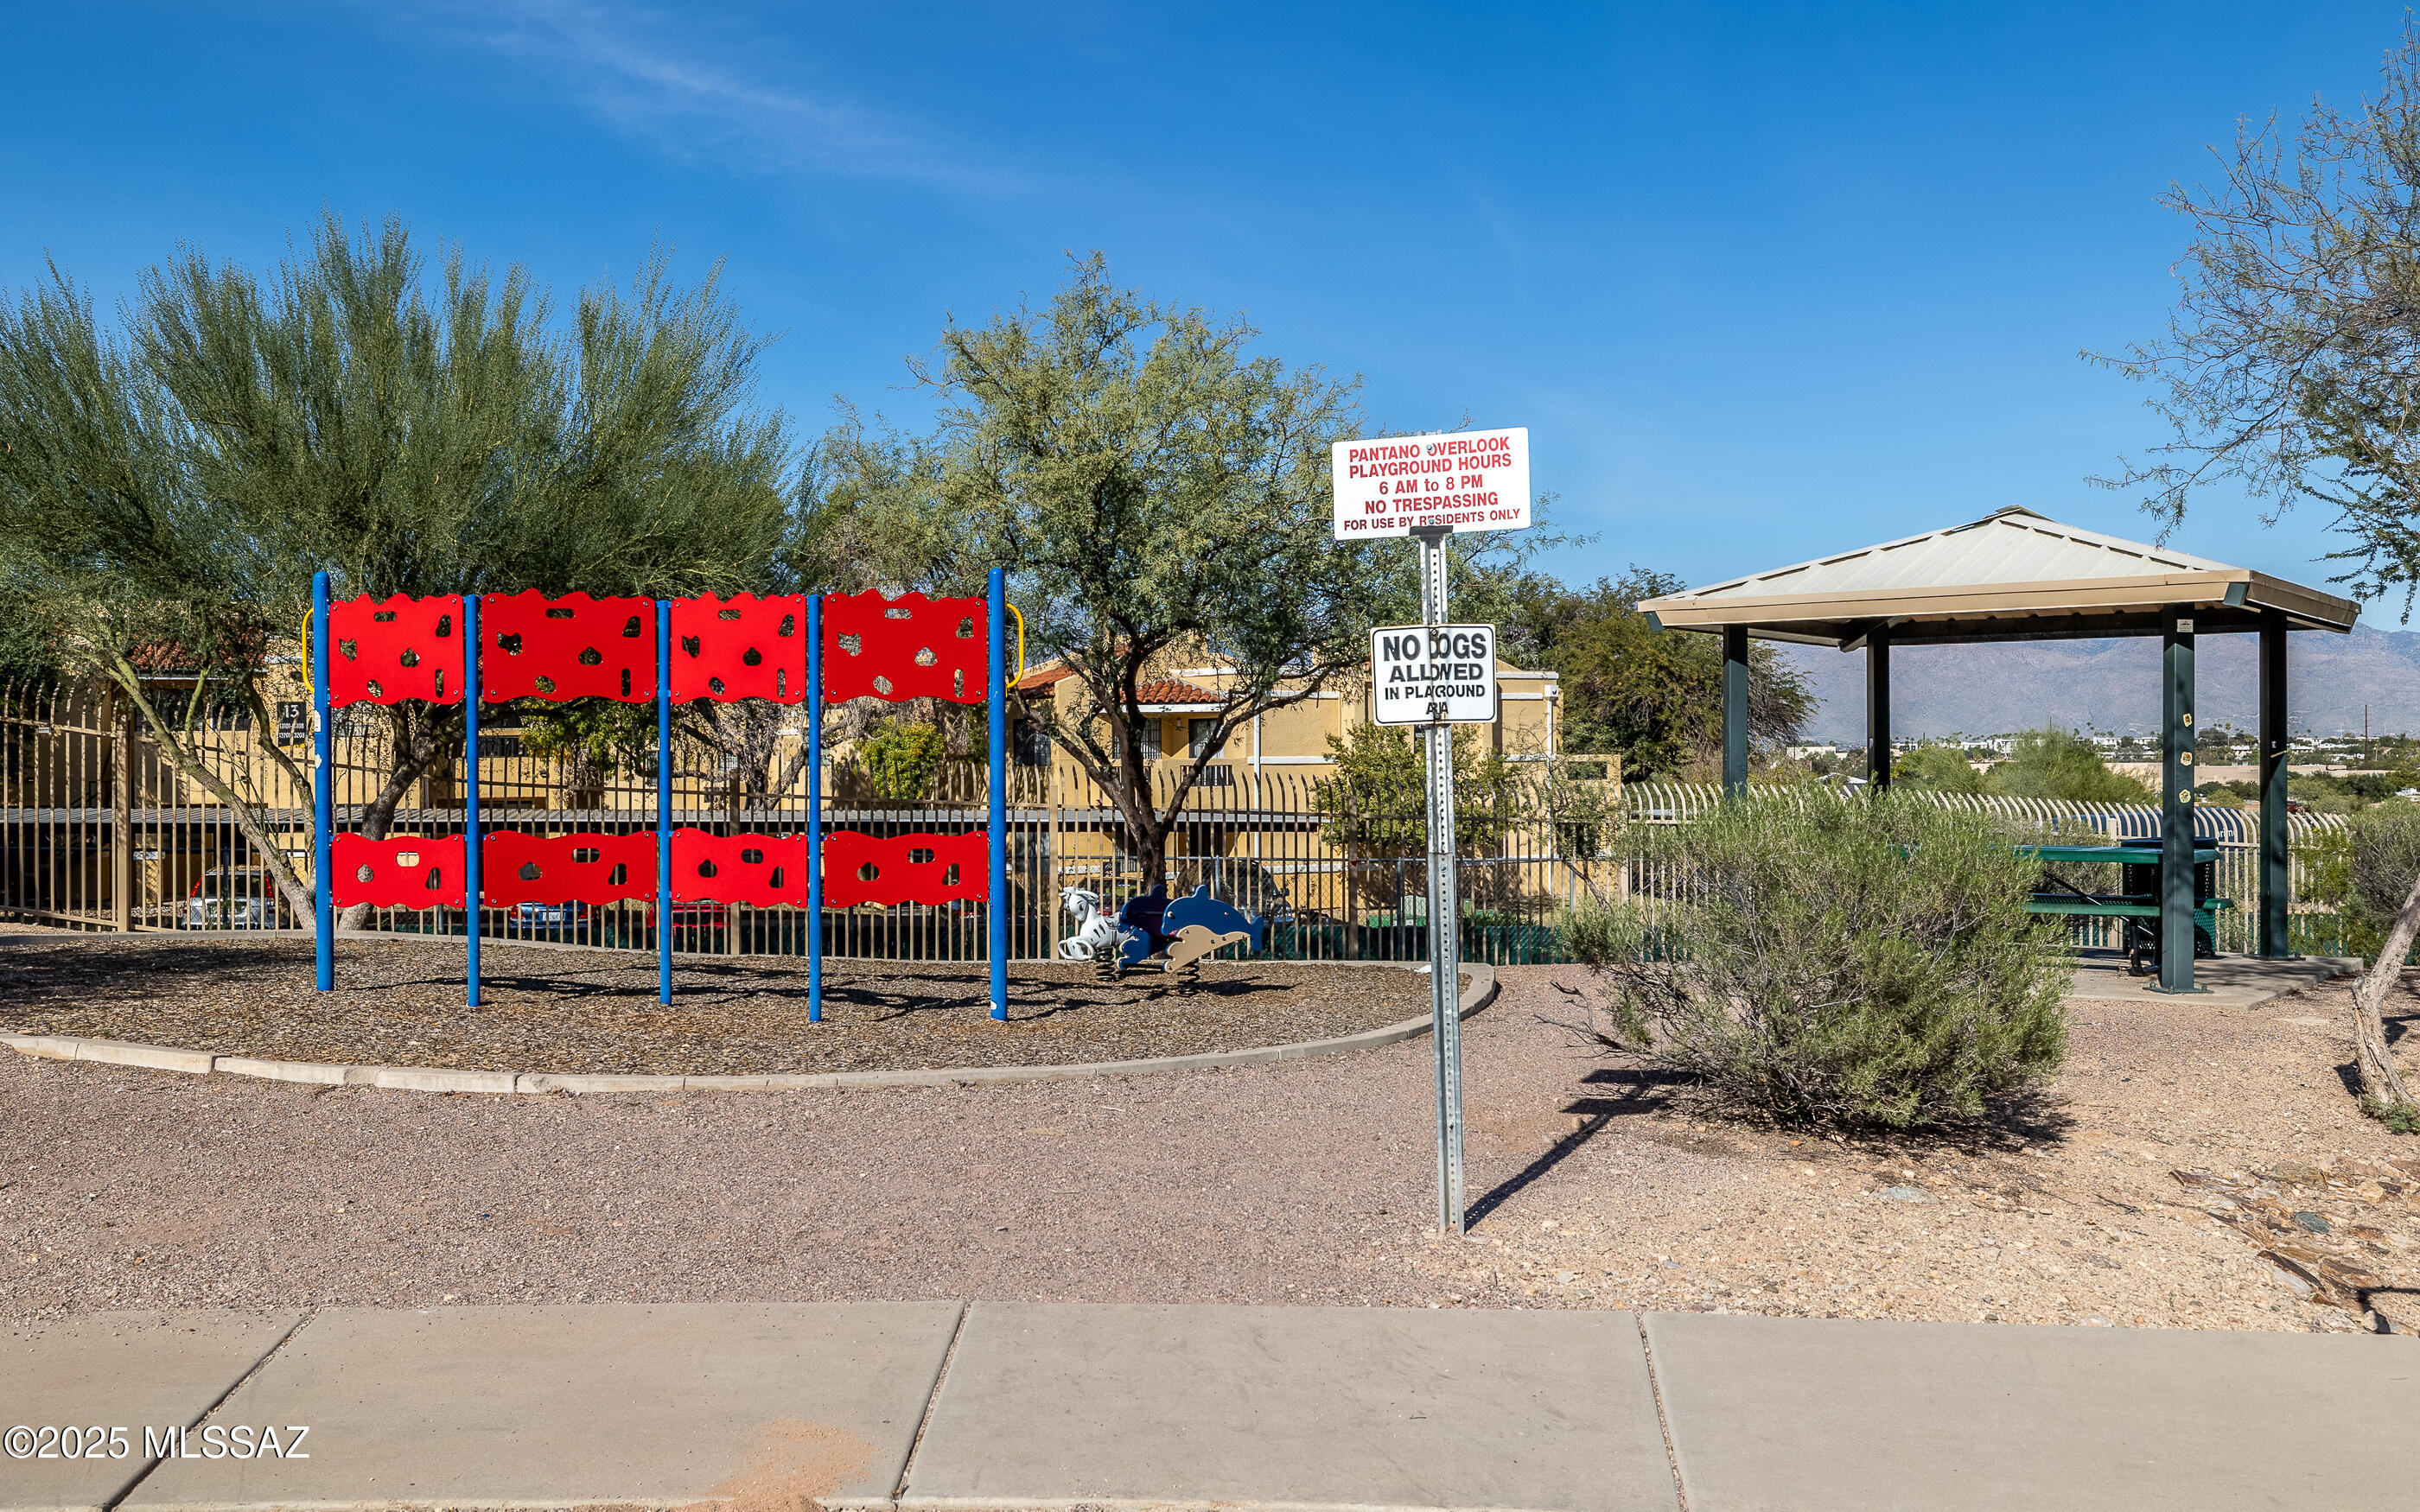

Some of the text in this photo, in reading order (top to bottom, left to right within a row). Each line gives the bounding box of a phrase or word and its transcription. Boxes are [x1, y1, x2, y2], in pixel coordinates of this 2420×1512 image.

[1349, 436, 1510, 462] PANTANO OVERLOOK
[1349, 454, 1512, 479] PLAYGROUND HOURS
[1379, 474, 1483, 495] 6 AM to 8 PM
[1366, 492, 1499, 514] NO TRESPASSING
[1344, 519, 1367, 530] FOR
[1372, 518, 1394, 529] USE
[1399, 516, 1415, 528] BY
[1489, 508, 1520, 521] ONLY
[1383, 632, 1487, 662] NO DOGS
[1389, 663, 1484, 683] ALLOWED
[1385, 684, 1486, 700] IN PLAGROUND
[283, 704, 300, 718] 13
